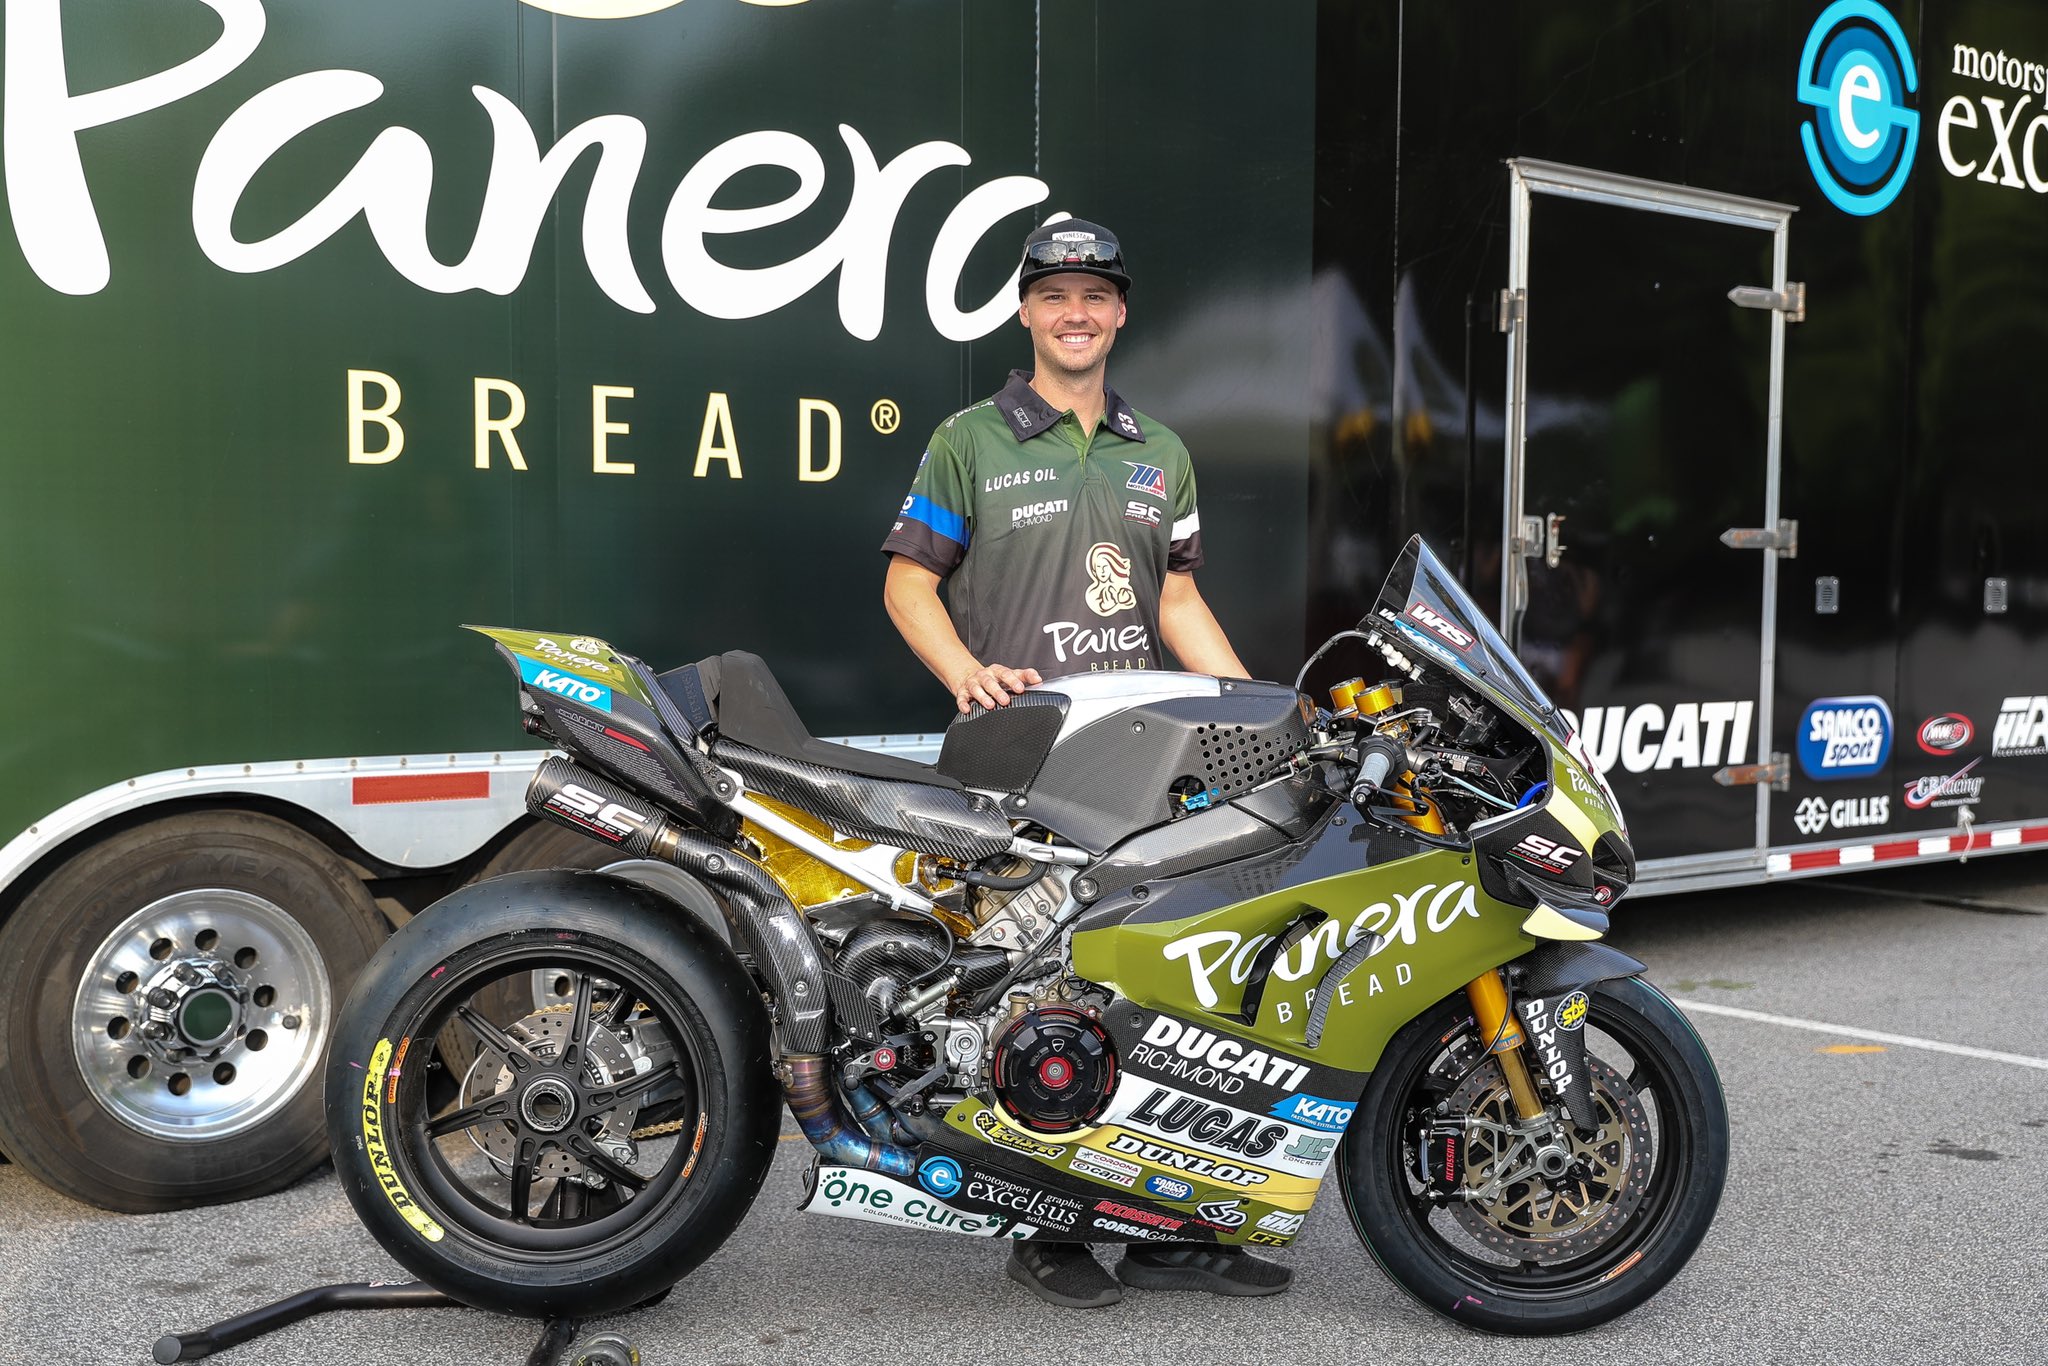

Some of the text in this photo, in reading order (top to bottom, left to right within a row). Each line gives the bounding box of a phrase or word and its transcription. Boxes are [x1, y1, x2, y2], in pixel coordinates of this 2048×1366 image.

[1117, 412, 1138, 434] 33
[985, 470, 1031, 492] LUCAS
[1012, 500, 1069, 521] DUCATI
[1012, 514, 1053, 530] RICHMOND
[1126, 500, 1162, 523] SC
[1411, 604, 1472, 646] WRS
[533, 669, 601, 703] KATO
[1809, 707, 1882, 742] SAMCO
[1830, 739, 1874, 762] sport
[547, 798, 629, 837] PROJECT
[552, 783, 648, 834] SC
[1829, 795, 1890, 829] GILLES
[1511, 846, 1568, 869] PROJECT
[1517, 834, 1583, 866] SC
[1562, 997, 1586, 1026] sbs
[1141, 1014, 1311, 1092] DUCATI
[1525, 998, 1573, 1095] DUNLOP
[1128, 1043, 1245, 1095] RICHMOND
[1126, 1088, 1288, 1158] LUCAS
[1294, 1097, 1352, 1125] KATO
[1109, 1134, 1268, 1187] DUNLOP
[1283, 1154, 1323, 1166] CONCRETE
[1284, 1135, 1336, 1161] JLC
[1446, 1138, 1455, 1182] ACCOSSATO
[1090, 1168, 1133, 1185] capit
[1094, 1154, 1139, 1172] CORDONA
[974, 1171, 1032, 1195] motorsport
[1153, 1177, 1188, 1192] SAMCO
[1160, 1187, 1182, 1196] sport
[823, 1178, 983, 1232] one cure
[967, 1181, 1078, 1225] excelsus
[1044, 1194, 1084, 1210] graphic
[1094, 1200, 1184, 1230] ACCOSSATO
[863, 1207, 904, 1222] COLORADO
[904, 1218, 928, 1228] STATE
[1025, 1214, 1071, 1233] solutions
